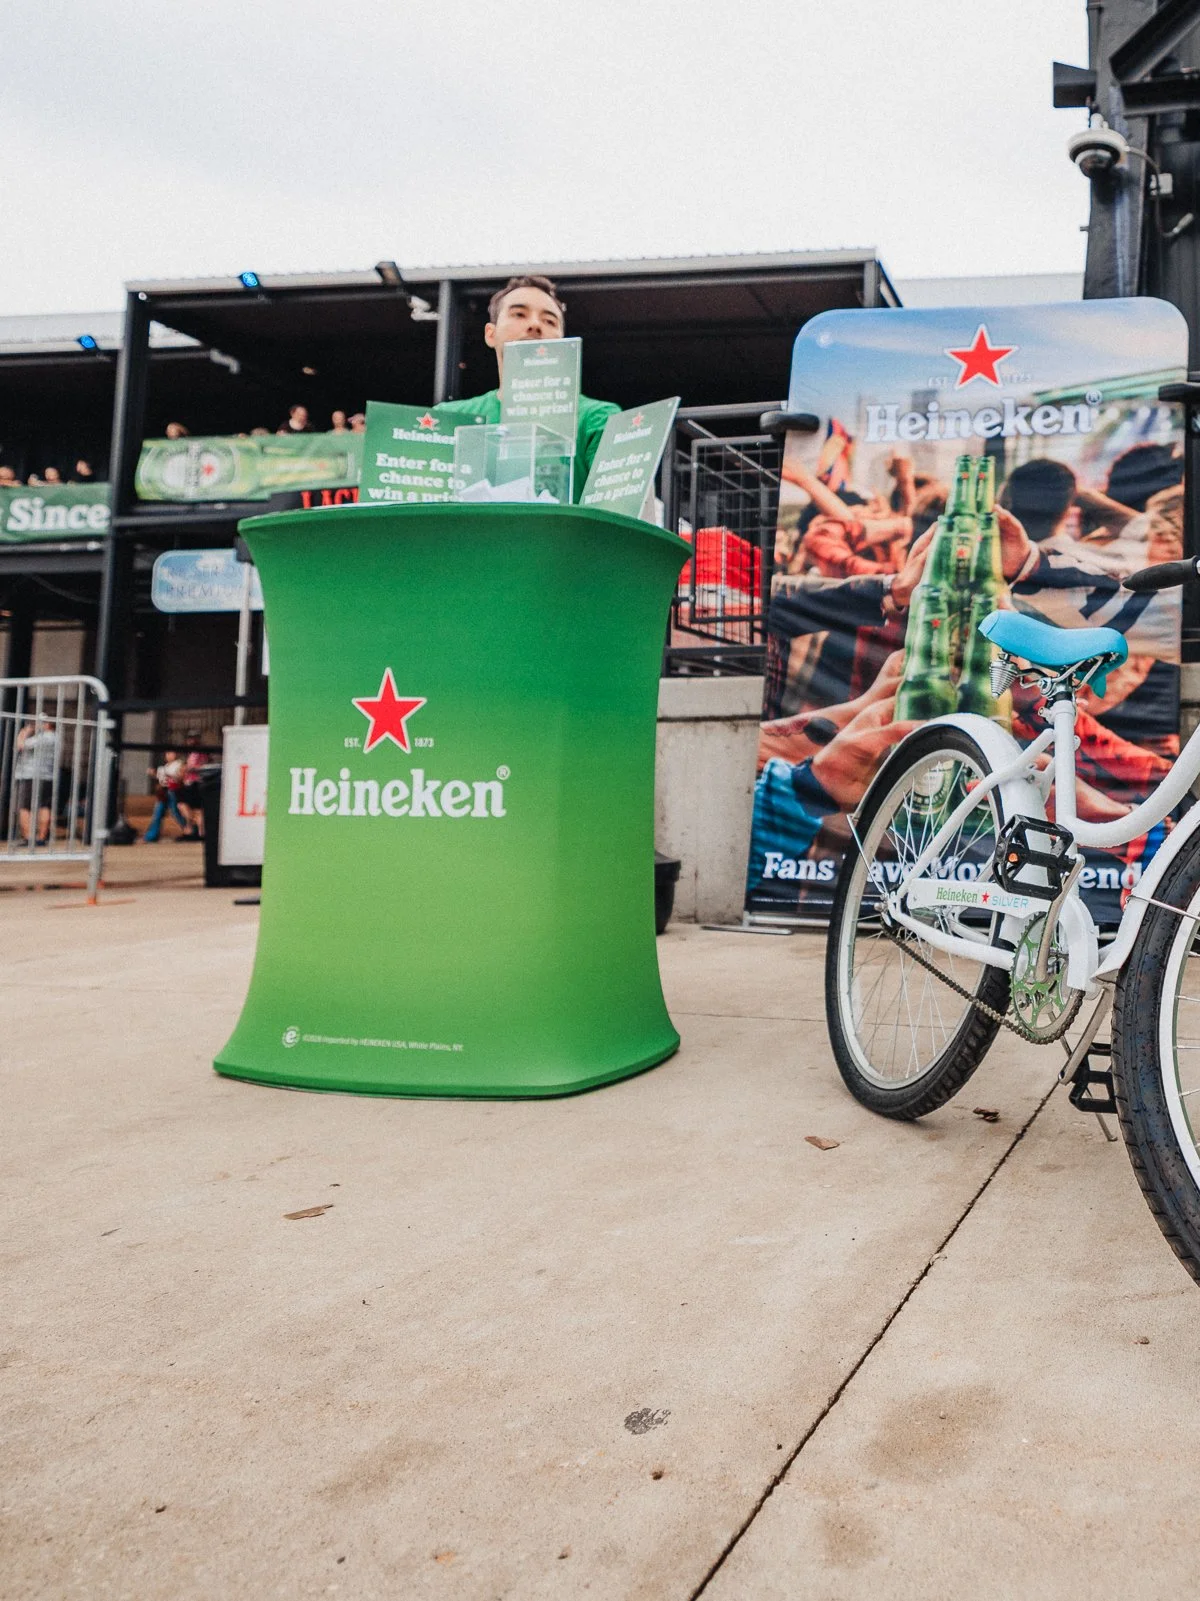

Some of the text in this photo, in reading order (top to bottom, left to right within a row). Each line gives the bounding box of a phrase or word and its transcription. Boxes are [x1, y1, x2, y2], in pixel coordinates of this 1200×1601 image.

[511, 378, 542, 389] Enter
[543, 376, 561, 387] for
[512, 390, 568, 402] chance to
[506, 405, 528, 416] win
[864, 397, 1093, 442] Heineken
[375, 453, 472, 475] Enter for a
[597, 457, 626, 473] Enter
[625, 453, 644, 467] for
[378, 470, 467, 490] chance to
[594, 471, 631, 488] chance
[367, 486, 404, 501] win
[406, 491, 418, 502] a
[7, 497, 112, 532] Since
[414, 738, 435, 748] 1873
[287, 767, 507, 818] Heineken
[762, 851, 836, 881] Fans
[936, 886, 1030, 909] Heineken SILVER
